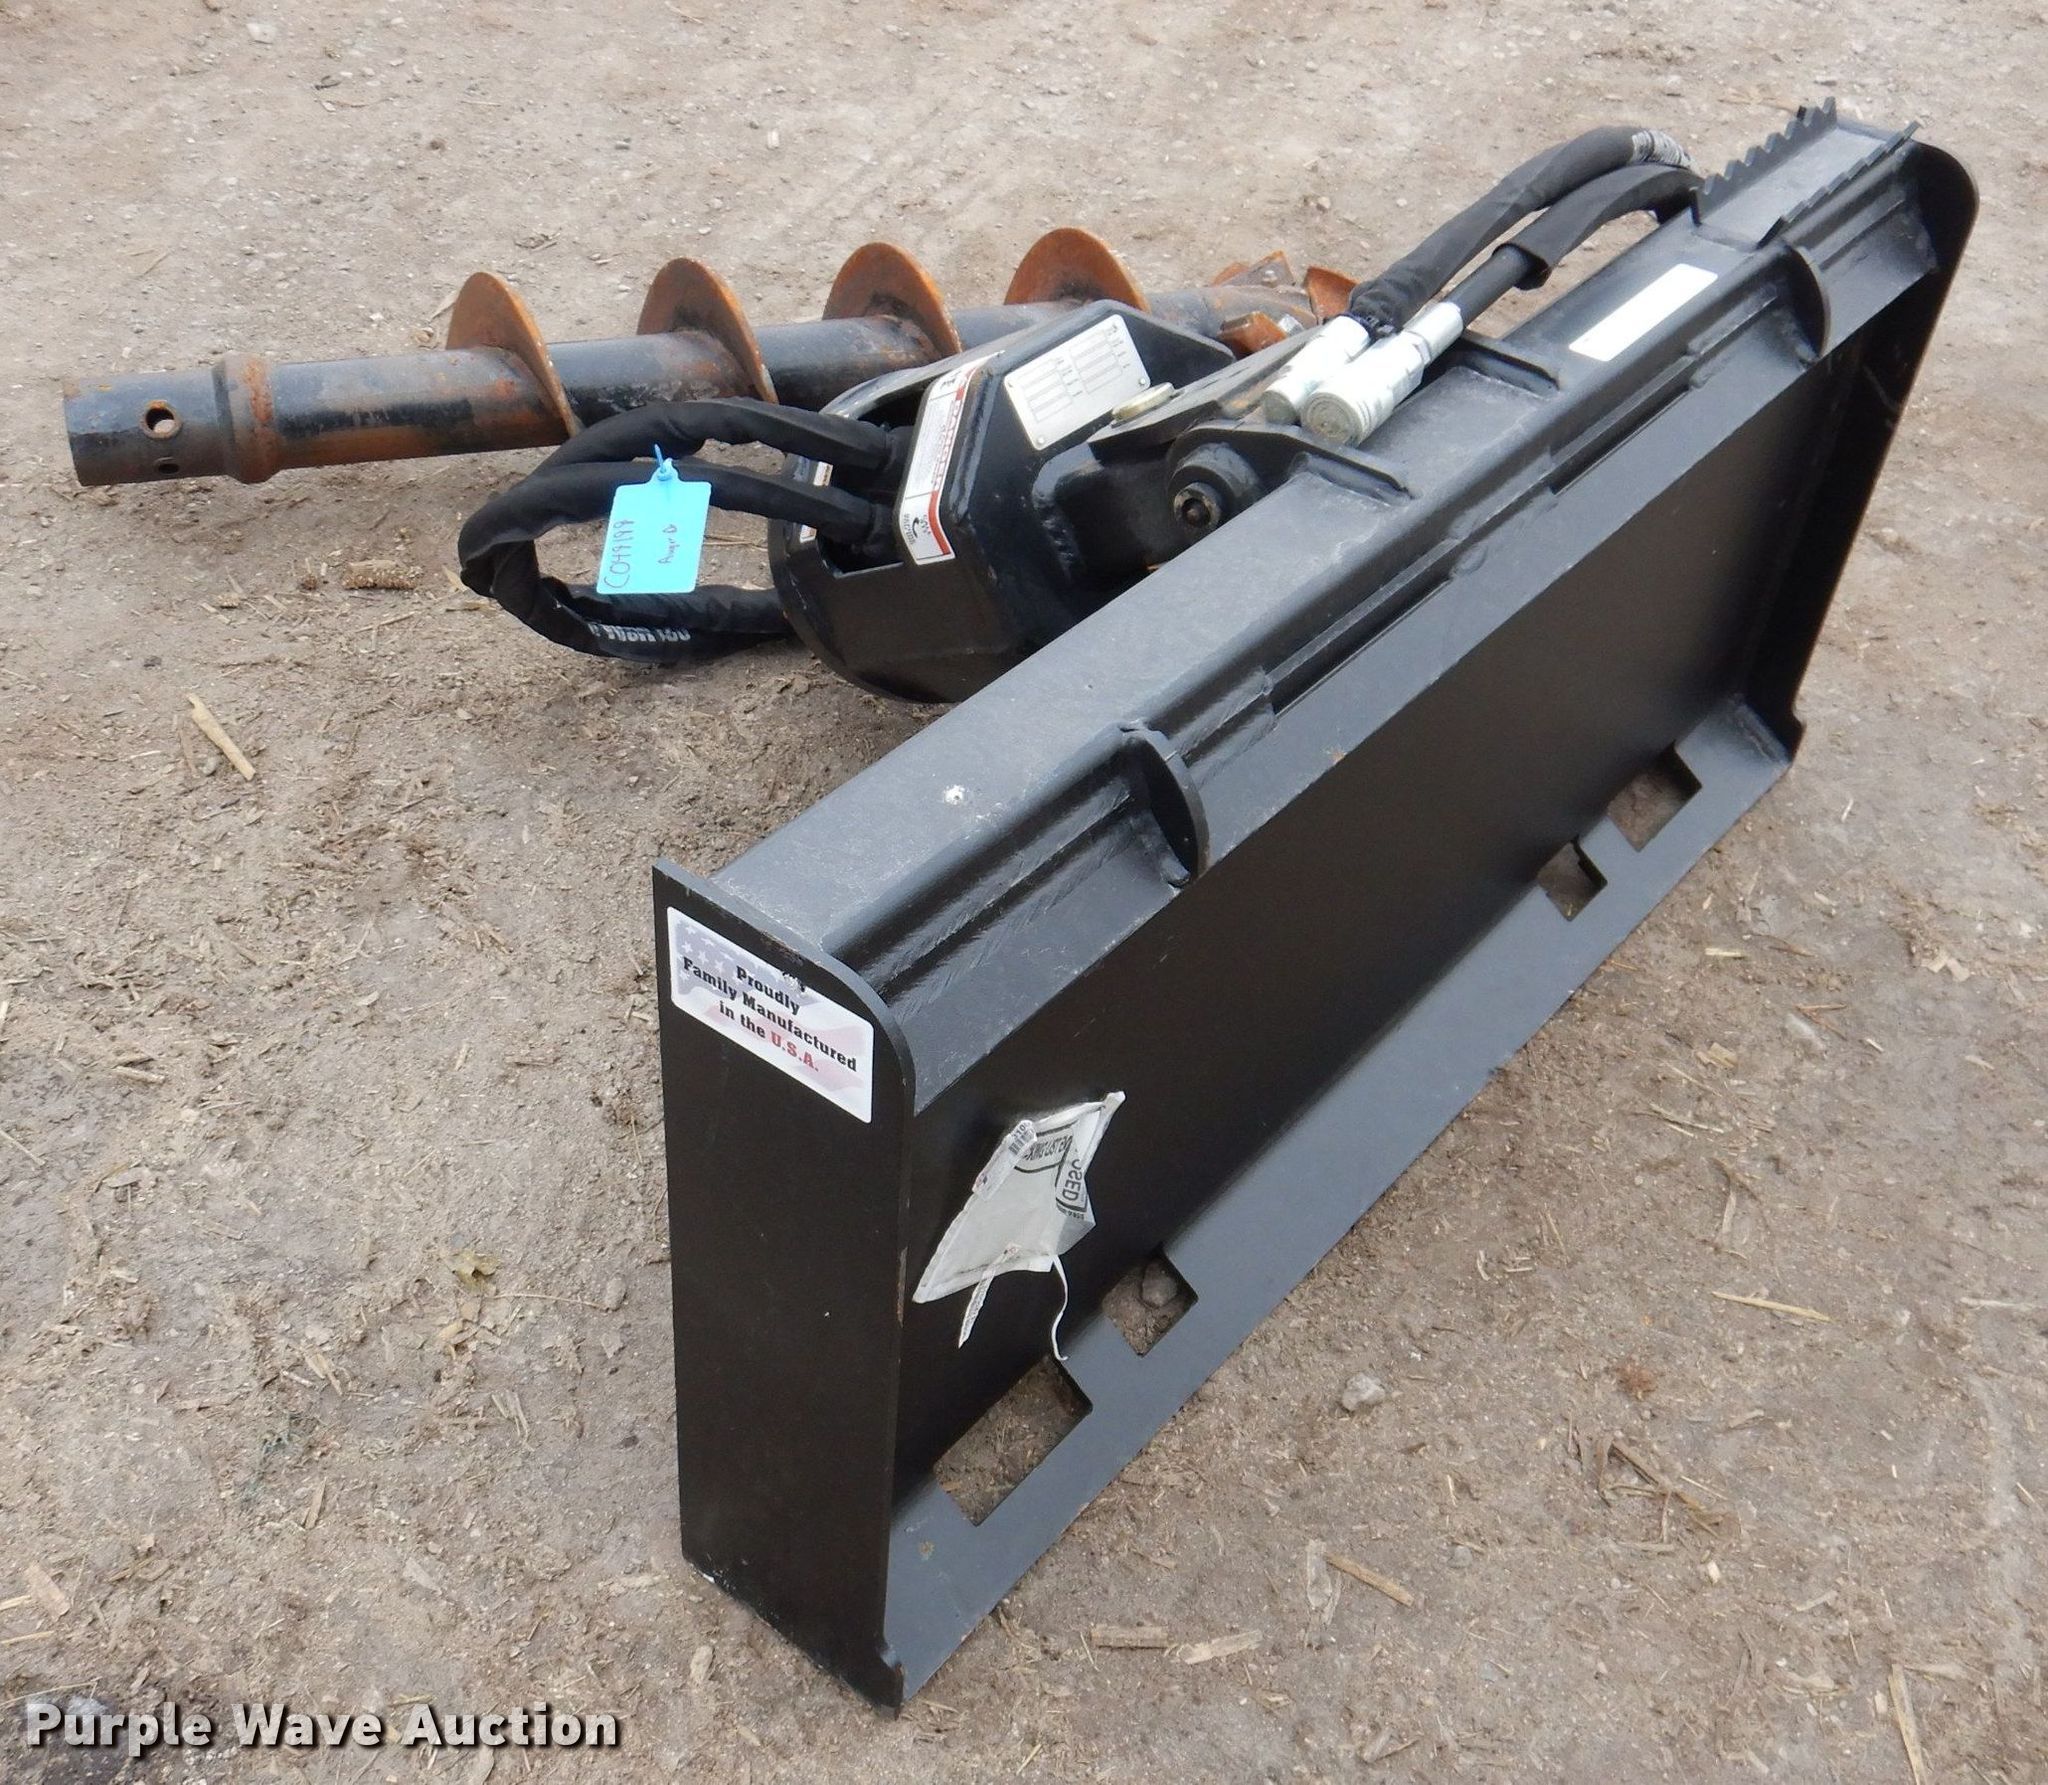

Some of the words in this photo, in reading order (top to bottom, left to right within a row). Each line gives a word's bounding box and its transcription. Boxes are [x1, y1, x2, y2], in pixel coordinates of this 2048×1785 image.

[683, 956, 738, 1001] Family
[742, 991, 858, 1073] Manufactured
[736, 965, 801, 1016] Proudly
[719, 1000, 736, 1021] in
[740, 1014, 766, 1039] the
[770, 1031, 820, 1073] U.S.A.
